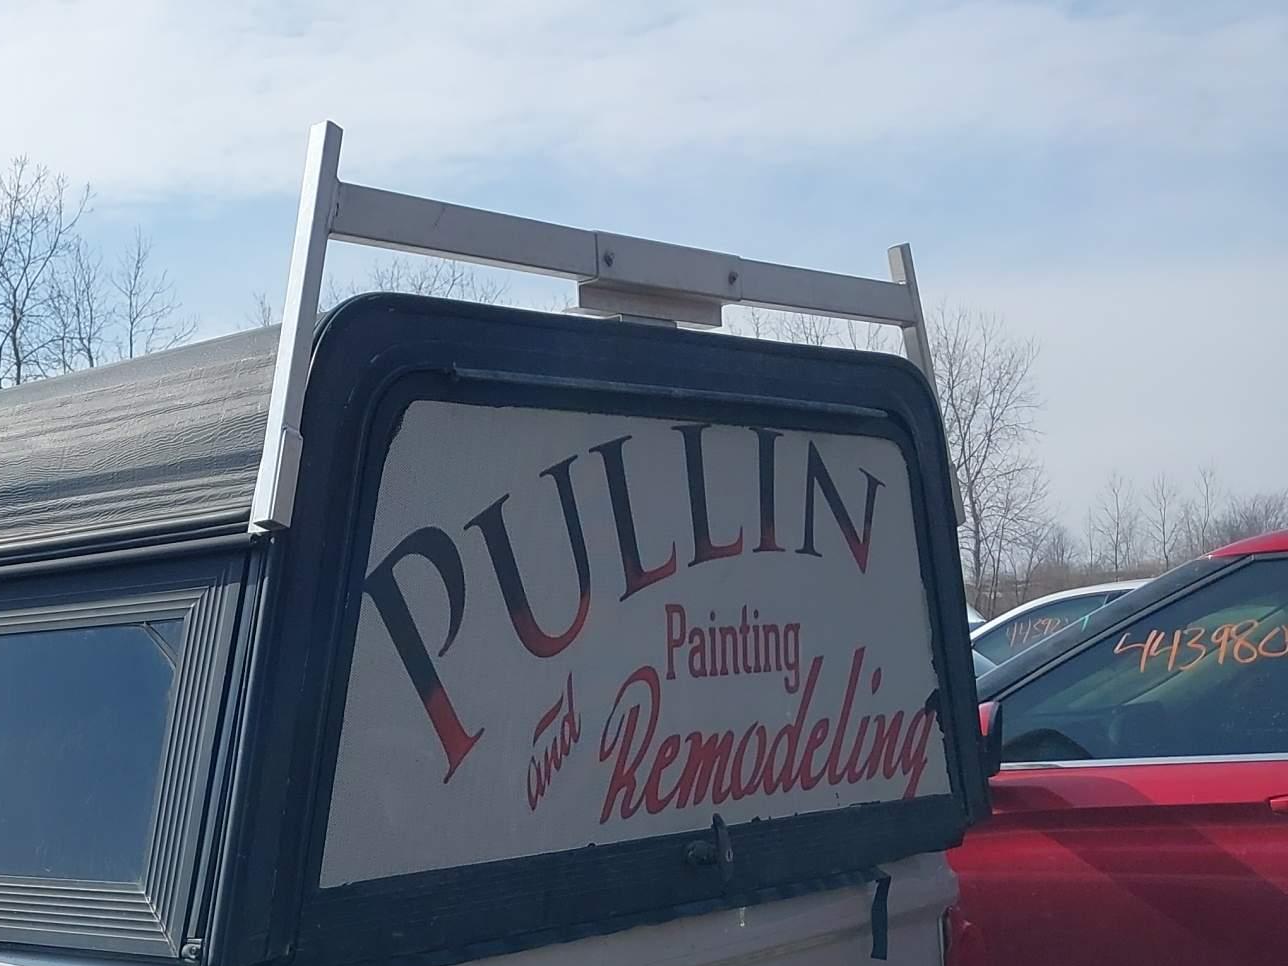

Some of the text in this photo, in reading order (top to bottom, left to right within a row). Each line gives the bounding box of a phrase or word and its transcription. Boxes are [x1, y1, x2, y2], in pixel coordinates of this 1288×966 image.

[362, 424, 886, 784] PULLIN
[664, 603, 801, 693] Painting
[526, 646, 937, 824] and Remodeling
